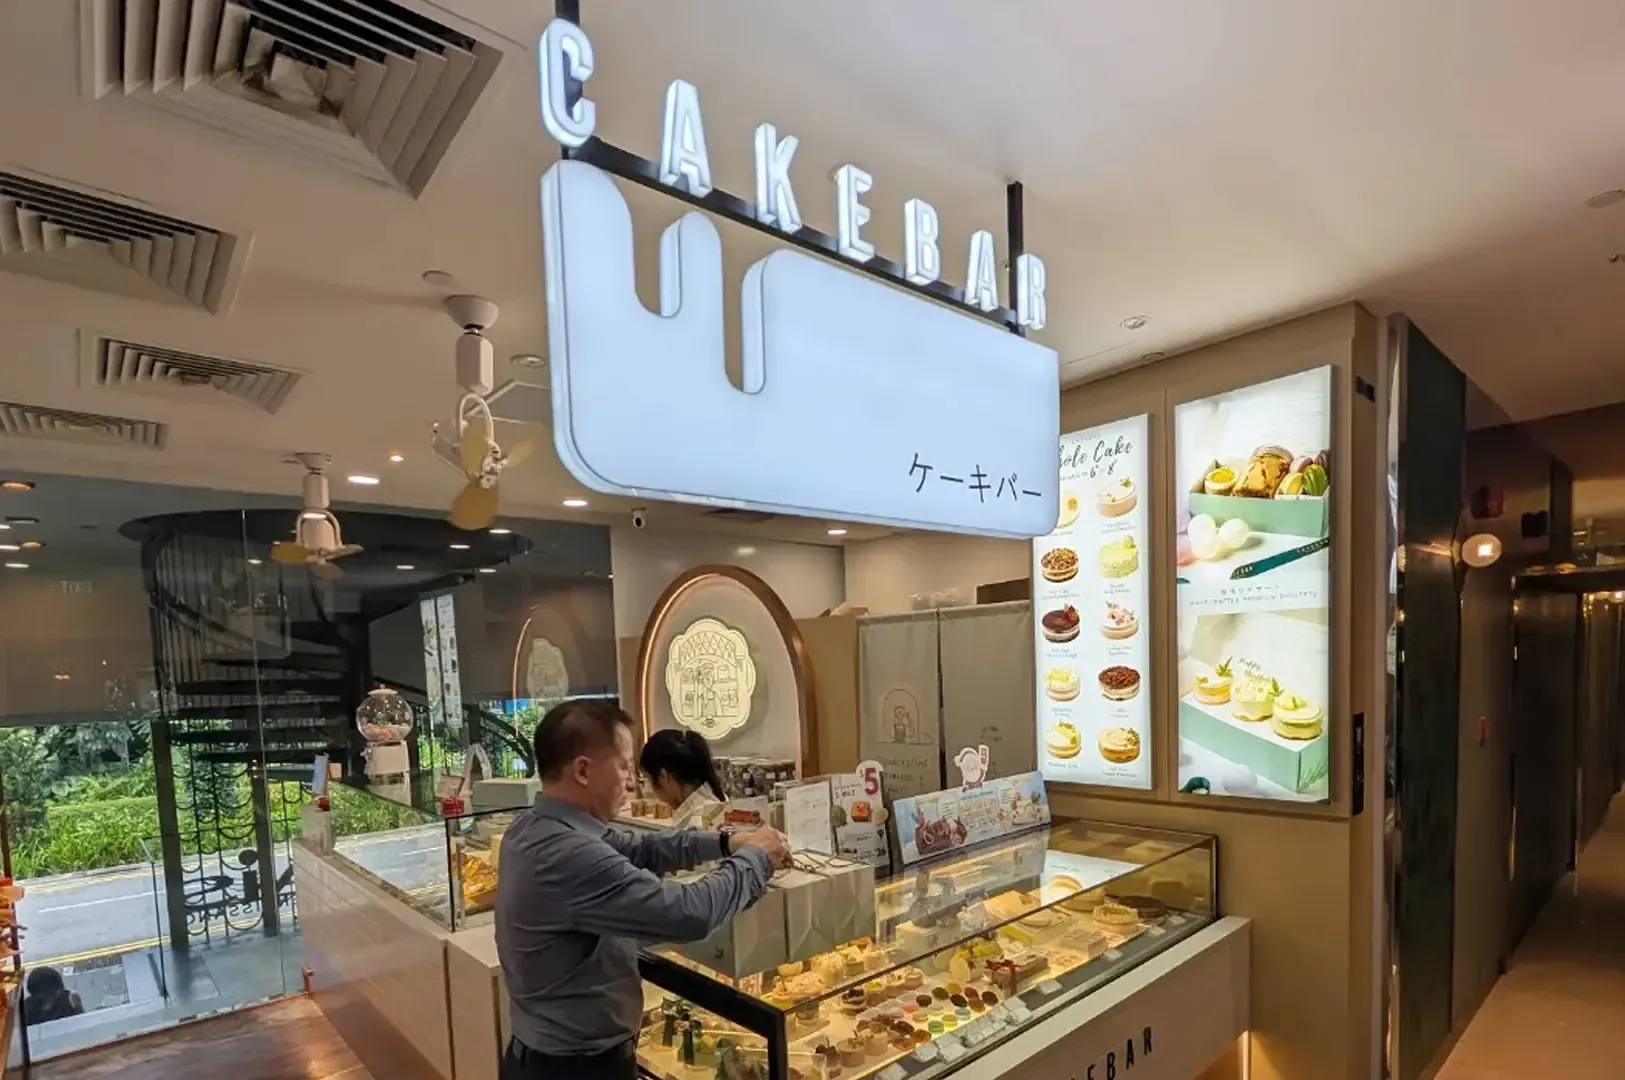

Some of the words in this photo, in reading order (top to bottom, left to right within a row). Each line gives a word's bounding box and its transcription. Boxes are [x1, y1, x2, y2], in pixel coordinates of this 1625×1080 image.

[1093, 435, 1135, 463] Cake
[909, 453, 1042, 502] ケーキバー
